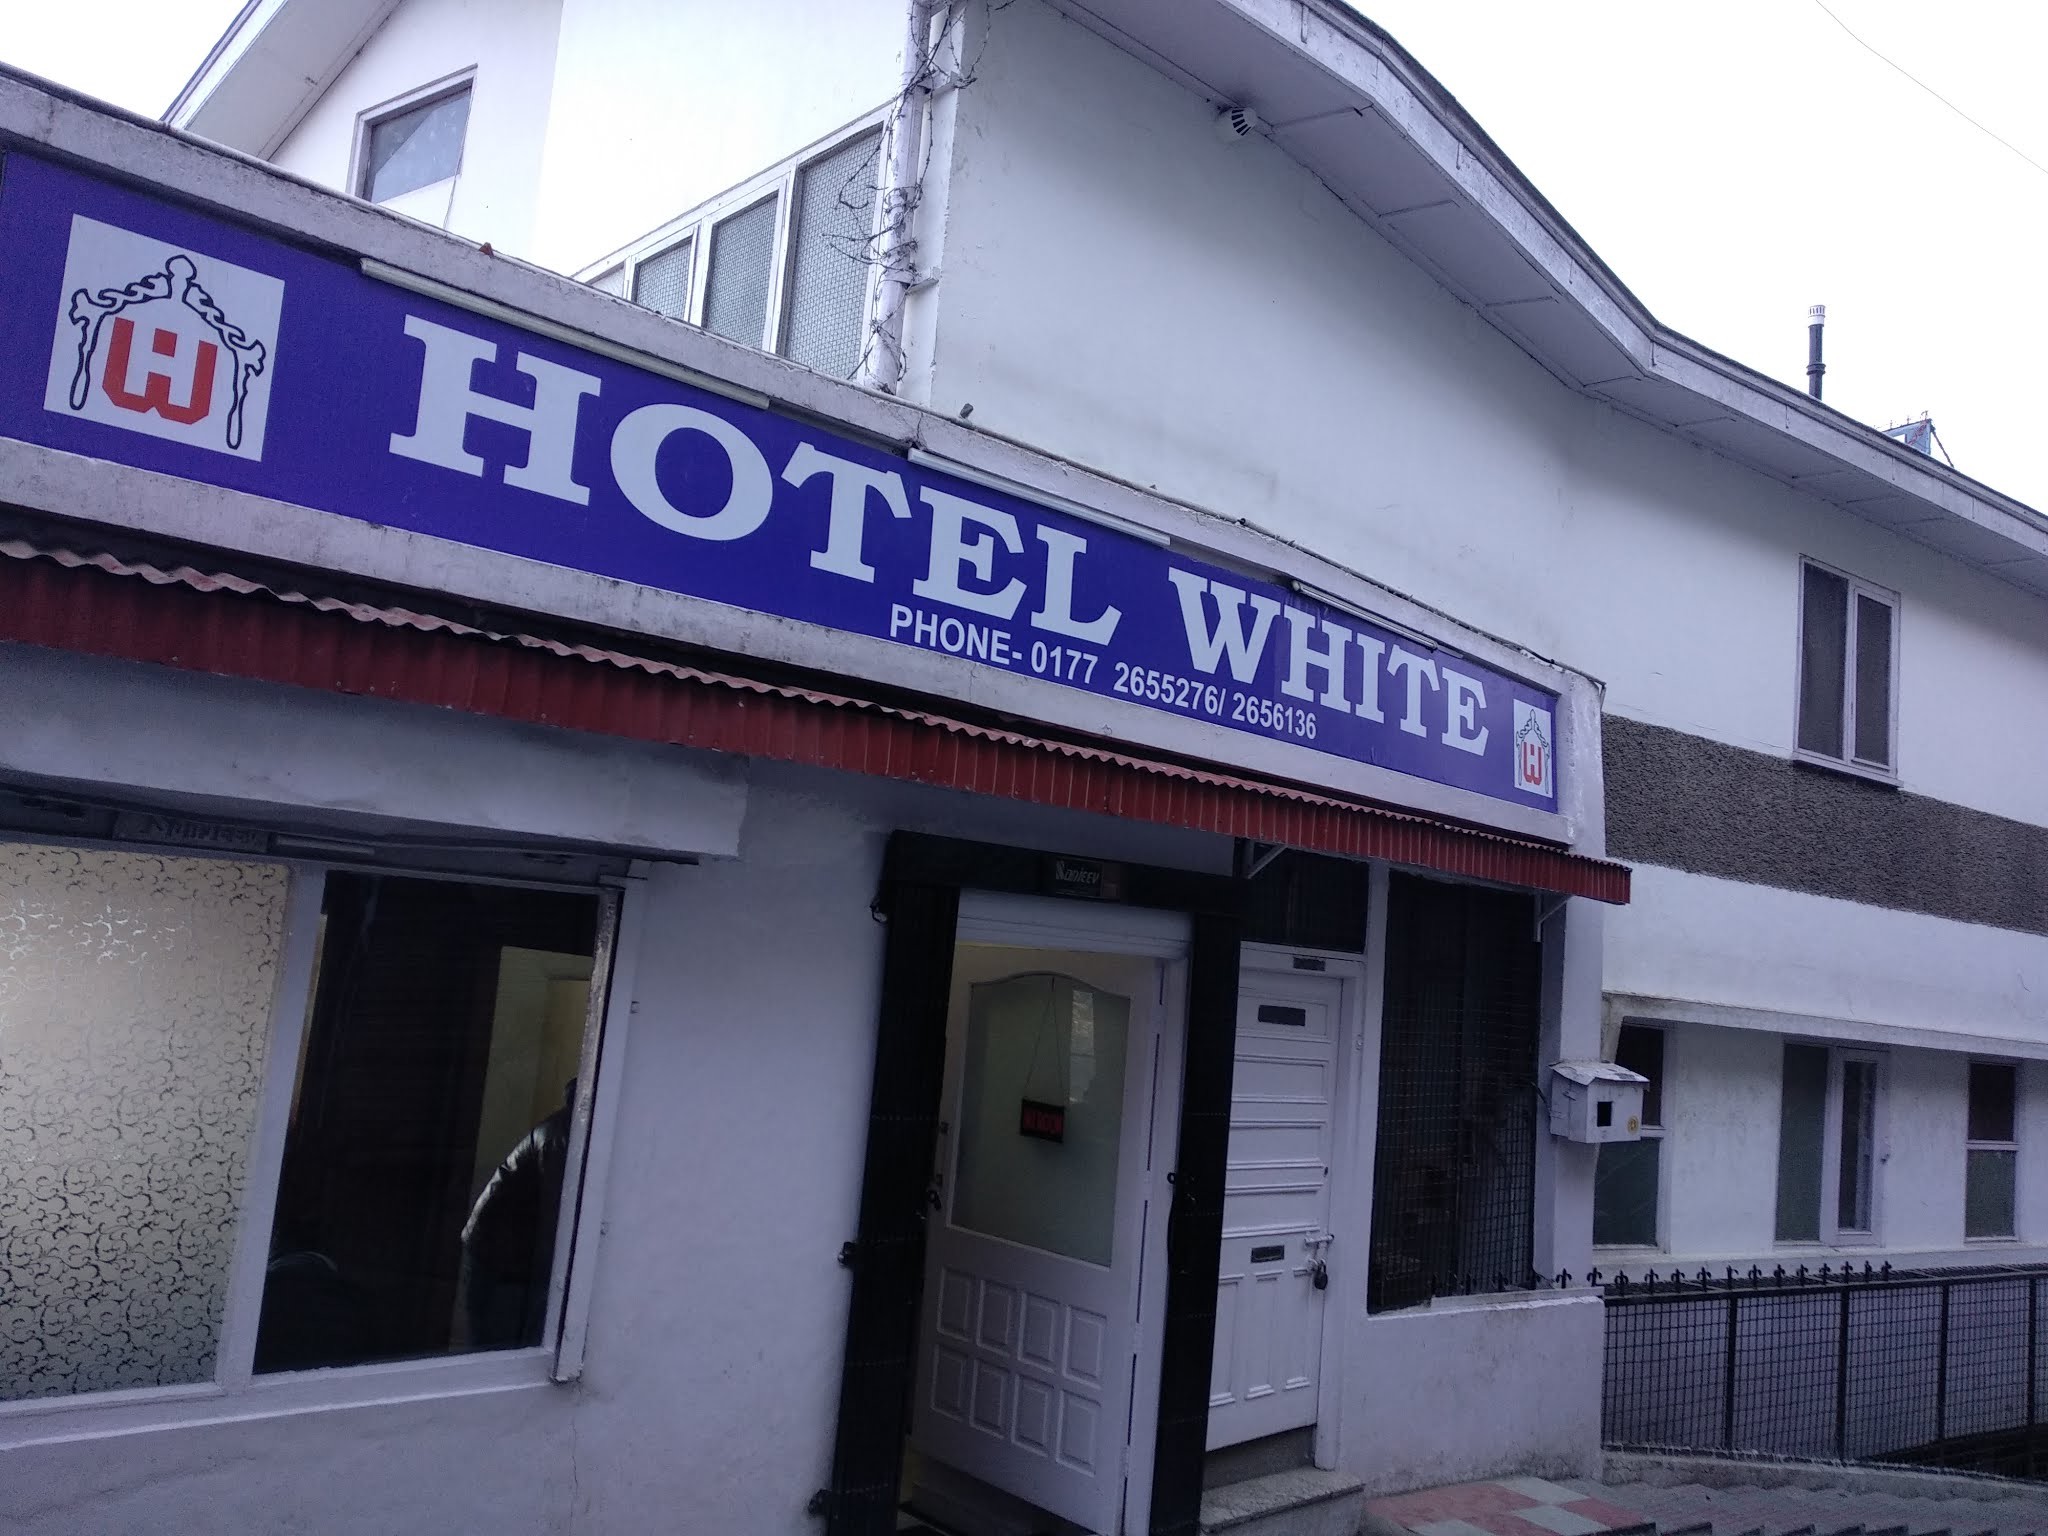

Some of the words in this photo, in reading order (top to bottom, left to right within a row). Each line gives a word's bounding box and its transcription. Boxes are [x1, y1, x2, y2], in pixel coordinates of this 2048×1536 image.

[388, 313, 1122, 647] HOTEL
[1167, 565, 1490, 757] WHITE
[889, 603, 1023, 665] PHONE-
[1031, 640, 1099, 684] 0177
[1113, 661, 1227, 717] 2655276/
[1231, 691, 1318, 741] 2656136
